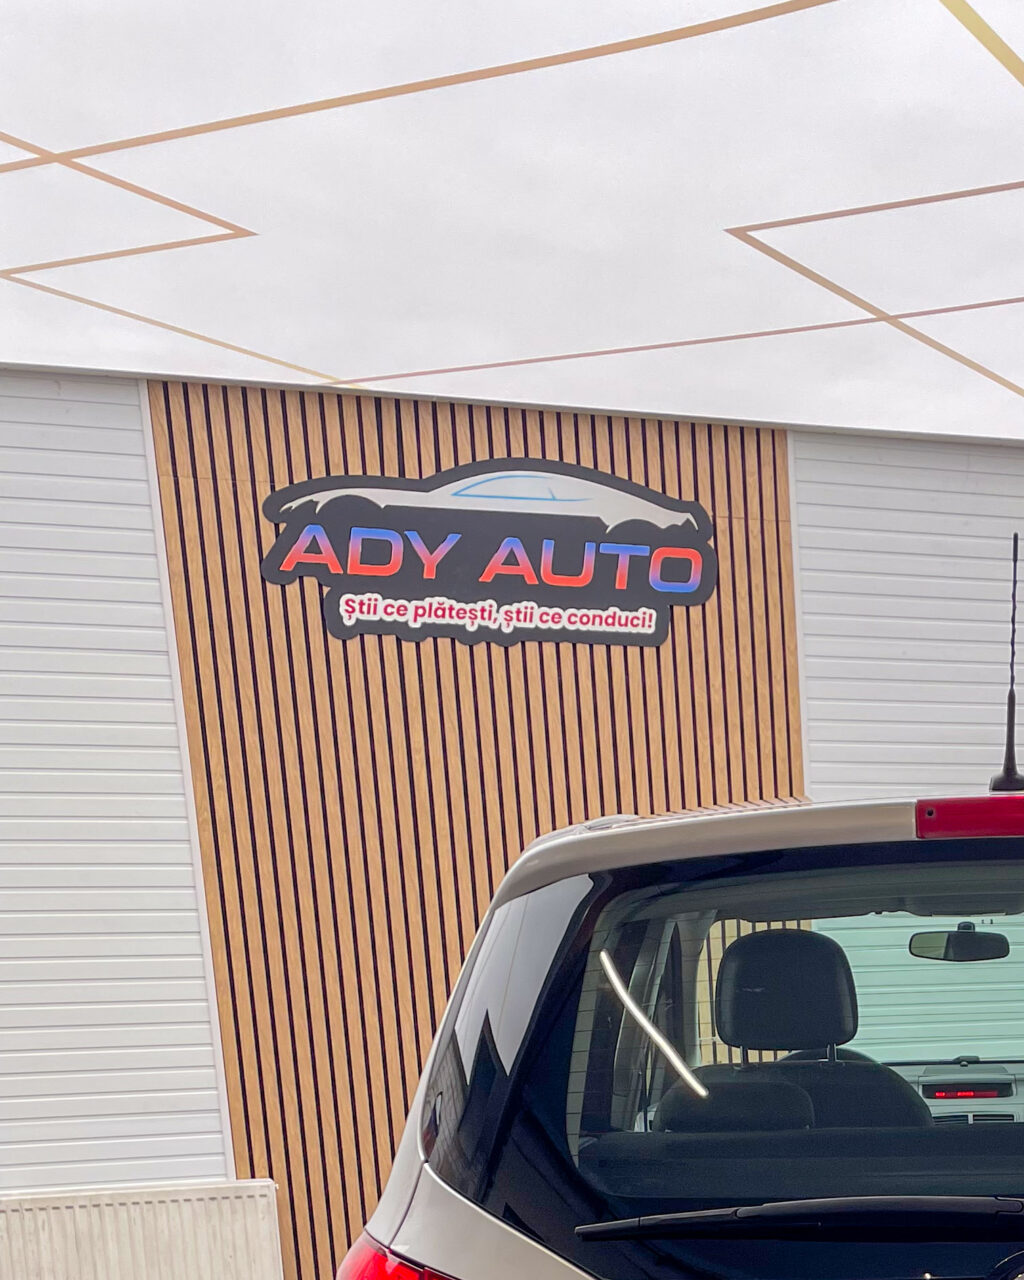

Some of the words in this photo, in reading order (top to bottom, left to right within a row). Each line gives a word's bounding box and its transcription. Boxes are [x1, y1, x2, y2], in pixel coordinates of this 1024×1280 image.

[279, 524, 462, 579] ADY
[478, 536, 703, 592] AUTO
[344, 597, 378, 626] Știi
[383, 601, 408, 616] ce
[413, 599, 499, 628] plătești,
[503, 607, 534, 630] știi
[538, 611, 562, 625] ce
[567, 608, 654, 629] conduci!
